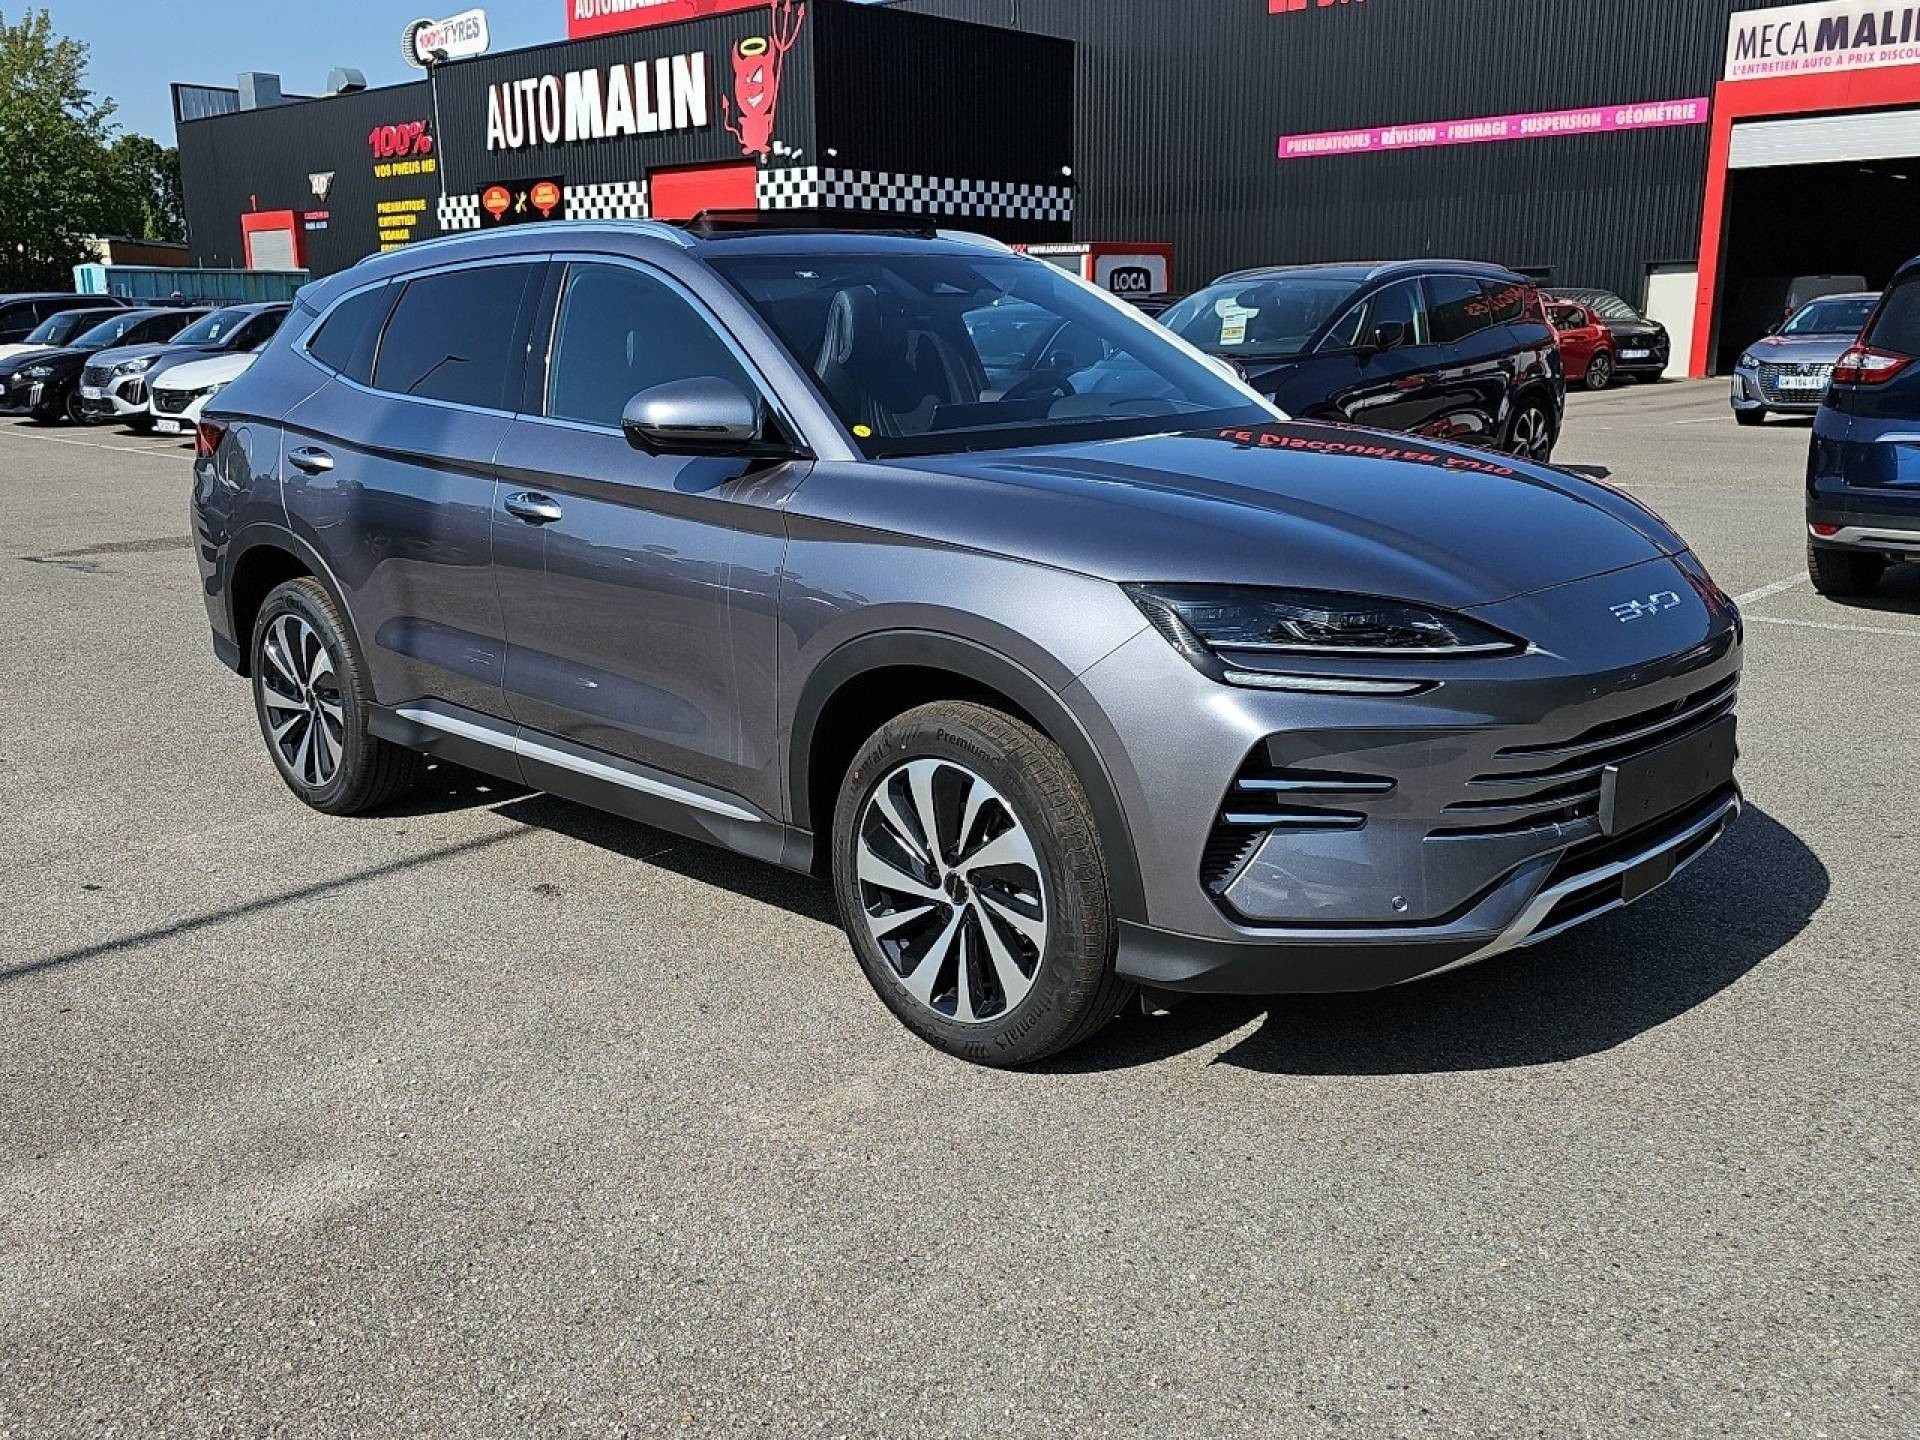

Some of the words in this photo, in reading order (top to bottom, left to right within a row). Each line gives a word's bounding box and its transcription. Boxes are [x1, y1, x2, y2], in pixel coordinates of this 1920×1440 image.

[1732, 59, 1798, 76] L'ENTRETIEN
[1802, 56, 1832, 70] AUTO
[1849, 51, 1876, 65] PRIX
[368, 119, 433, 158] 100%
[1286, 133, 1371, 153] PNEUMATIQUES
[1381, 126, 1436, 145] RÉVISION
[1448, 120, 1508, 139] FREINAGE
[1520, 112, 1602, 134] SUSPENSION
[1615, 102, 1697, 125] GÉOMÉTRIE
[374, 163, 391, 178] VOS
[392, 160, 421, 176] PNEUS
[1113, 272, 1147, 290] LOCA
[1609, 590, 1681, 623] BYD
